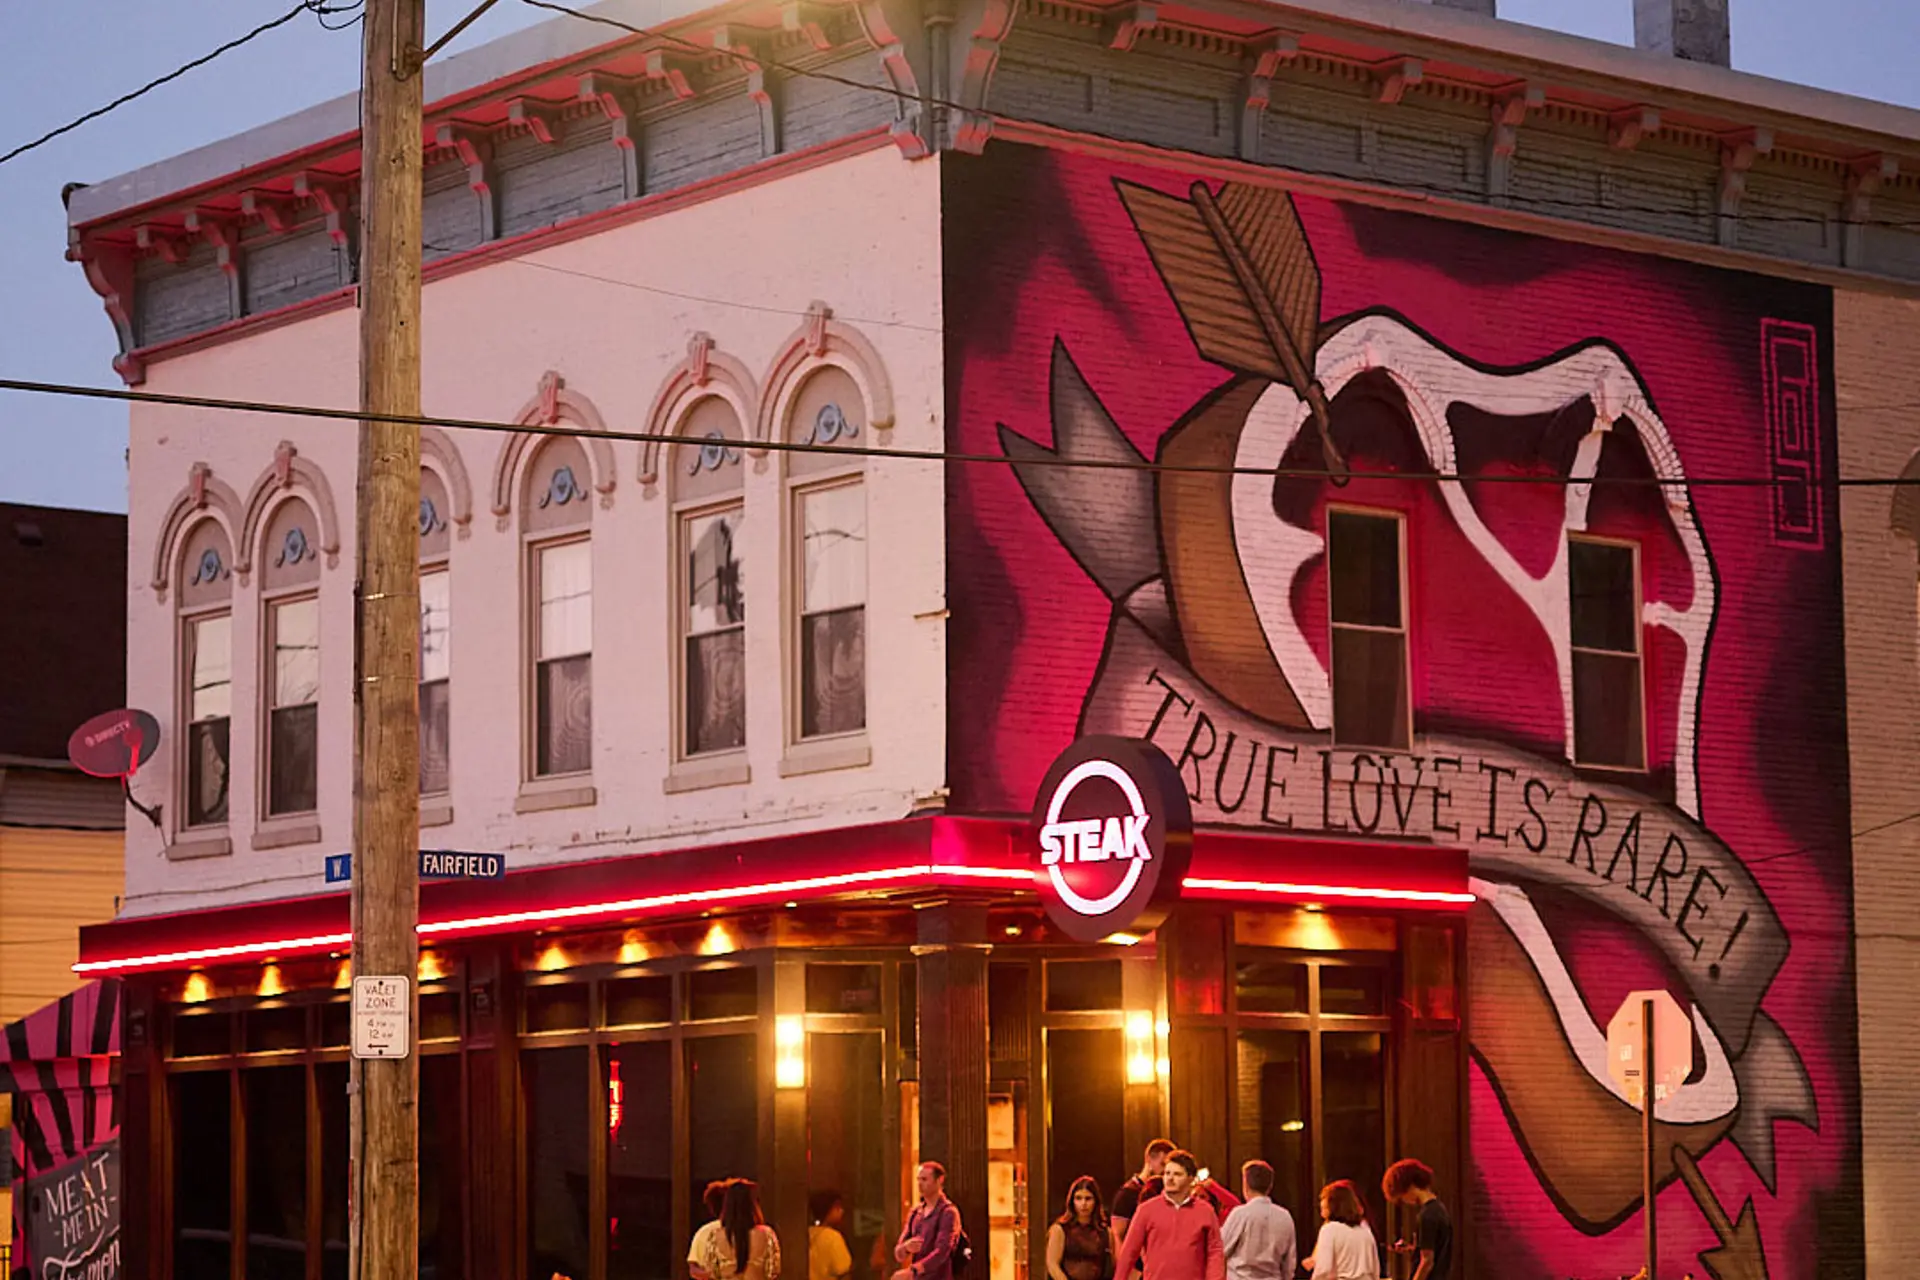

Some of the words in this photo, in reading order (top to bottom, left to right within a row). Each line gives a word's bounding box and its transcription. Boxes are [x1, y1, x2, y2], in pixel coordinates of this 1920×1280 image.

[1145, 668, 1299, 828] TRUE
[1317, 750, 1461, 841] LOVE
[1477, 758, 1556, 853] IS
[1566, 793, 1749, 979] RARE!
[1040, 814, 1152, 865] STEAK
[423, 854, 498, 877] FAIRFIELD
[364, 984, 396, 995] VALET
[366, 997, 396, 1008] ZONE
[367, 1018, 375, 1027] 4
[369, 1028, 380, 1039] 12
[46, 1152, 109, 1222] MEAT
